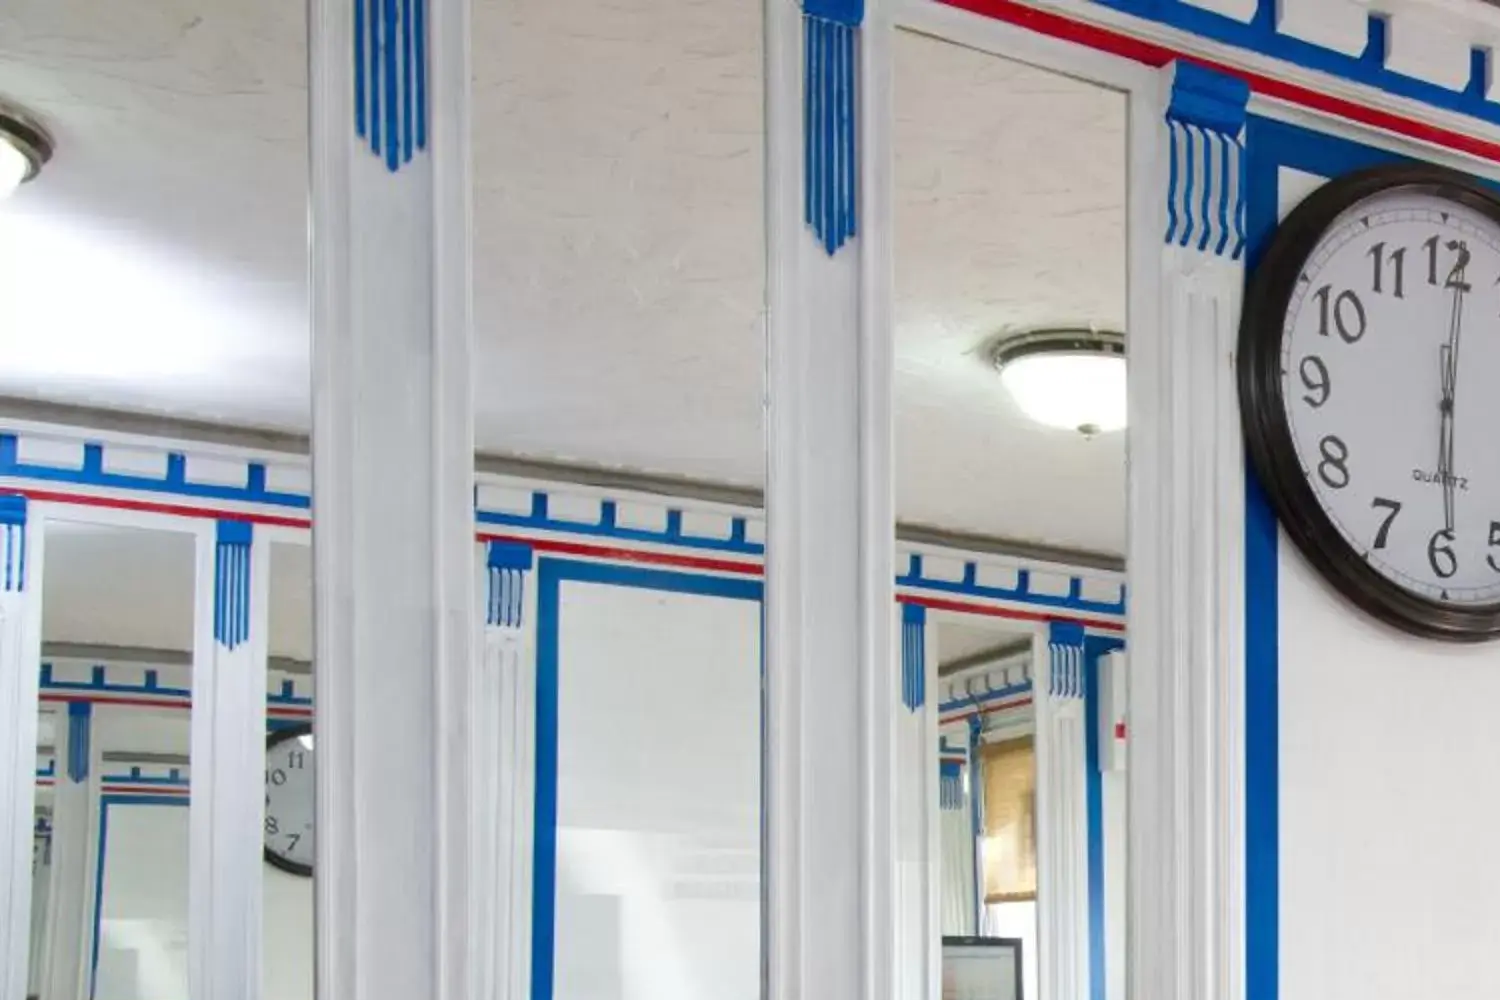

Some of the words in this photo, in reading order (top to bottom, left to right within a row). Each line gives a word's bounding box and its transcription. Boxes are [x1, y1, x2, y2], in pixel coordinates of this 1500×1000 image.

[1367, 240, 1407, 299] 11
[1423, 234, 1471, 292] 12
[1313, 284, 1367, 344] 10
[1299, 355, 1332, 408] 9
[1317, 434, 1350, 490] 8
[1371, 497, 1402, 549] 7
[1427, 527, 1458, 578] 6
